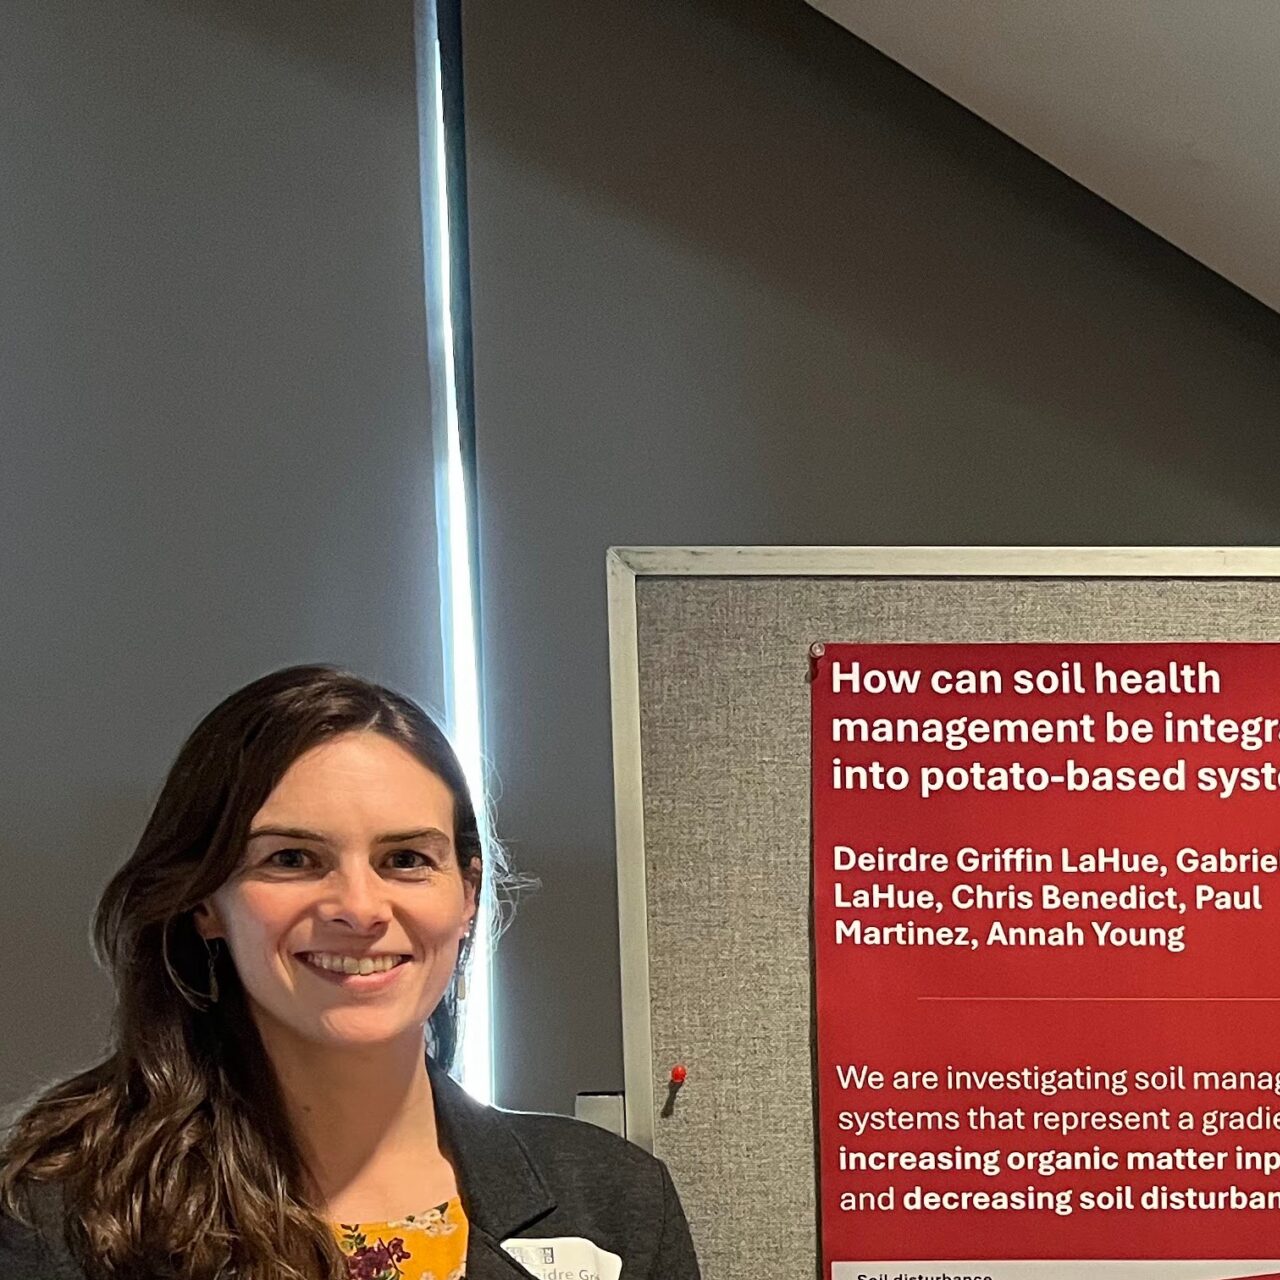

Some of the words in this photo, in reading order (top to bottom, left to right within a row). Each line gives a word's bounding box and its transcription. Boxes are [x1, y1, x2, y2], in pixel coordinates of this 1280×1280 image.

[832, 661, 922, 694] How
[930, 669, 1002, 695] can
[1013, 661, 1086, 695] soil
[1095, 661, 1220, 695] health
[832, 714, 1096, 751] management
[1106, 711, 1154, 744] be
[832, 757, 910, 791] into
[921, 759, 1186, 798] potato-based
[833, 845, 949, 873] Deirdre
[956, 847, 1053, 873] Griffin
[1061, 847, 1168, 878] LaHue,
[834, 882, 944, 914] LaHue,
[951, 884, 1034, 910] Chris
[1042, 884, 1187, 915] Benedict,
[1196, 884, 1263, 910] Paul
[835, 919, 979, 951] Martinez,
[986, 921, 1084, 947] Annah
[1091, 921, 1186, 953] Young
[835, 1065, 885, 1090] We
[892, 1071, 939, 1090] are
[947, 1065, 1128, 1096] investigating
[1134, 1065, 1186, 1091] soil
[838, 1107, 960, 1136] systems
[966, 1105, 1026, 1130] that
[1033, 1108, 1171, 1136] represent
[1177, 1111, 1194, 1131] a
[839, 1145, 1001, 1176] increasing
[1006, 1145, 1119, 1176] organic
[1127, 1148, 1229, 1171] matter
[840, 1186, 895, 1211] and
[903, 1185, 1073, 1216] decreasing
[1079, 1185, 1135, 1210] soil
